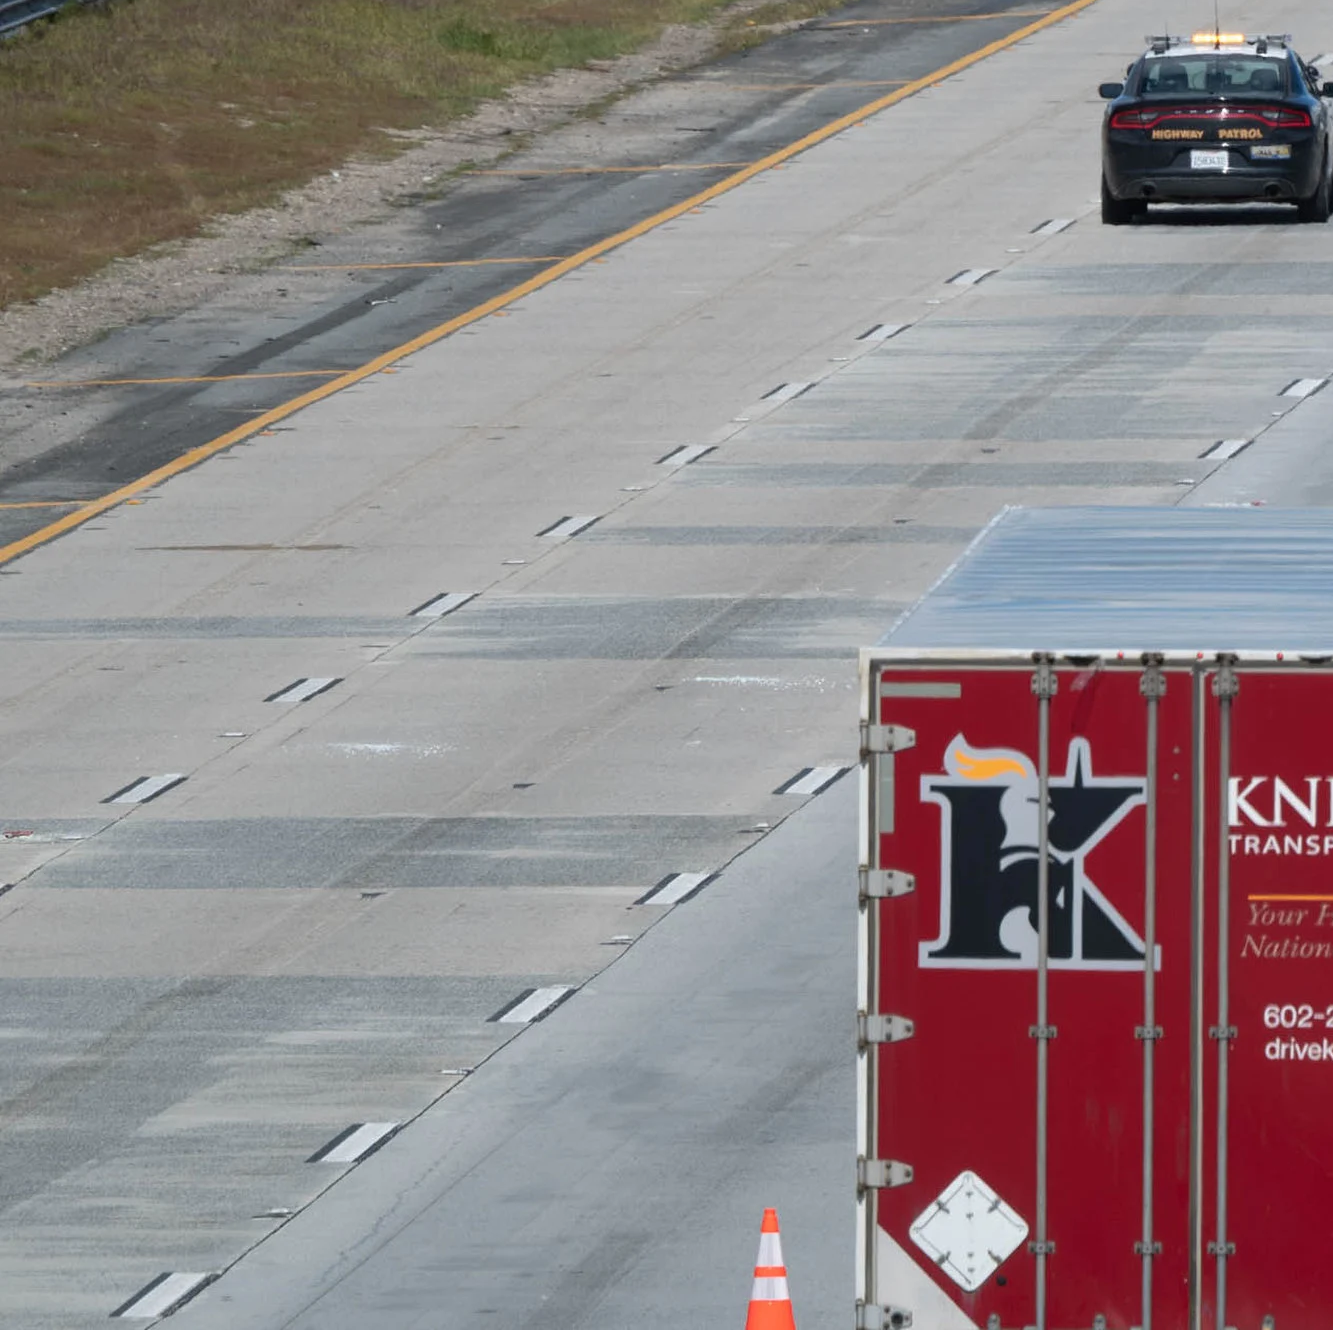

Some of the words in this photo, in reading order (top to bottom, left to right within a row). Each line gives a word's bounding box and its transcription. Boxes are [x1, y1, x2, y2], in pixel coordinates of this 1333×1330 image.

[1151, 129, 1204, 140] HIGHWAY
[1218, 128, 1263, 139] PATROL
[1248, 903, 1309, 927] Your
